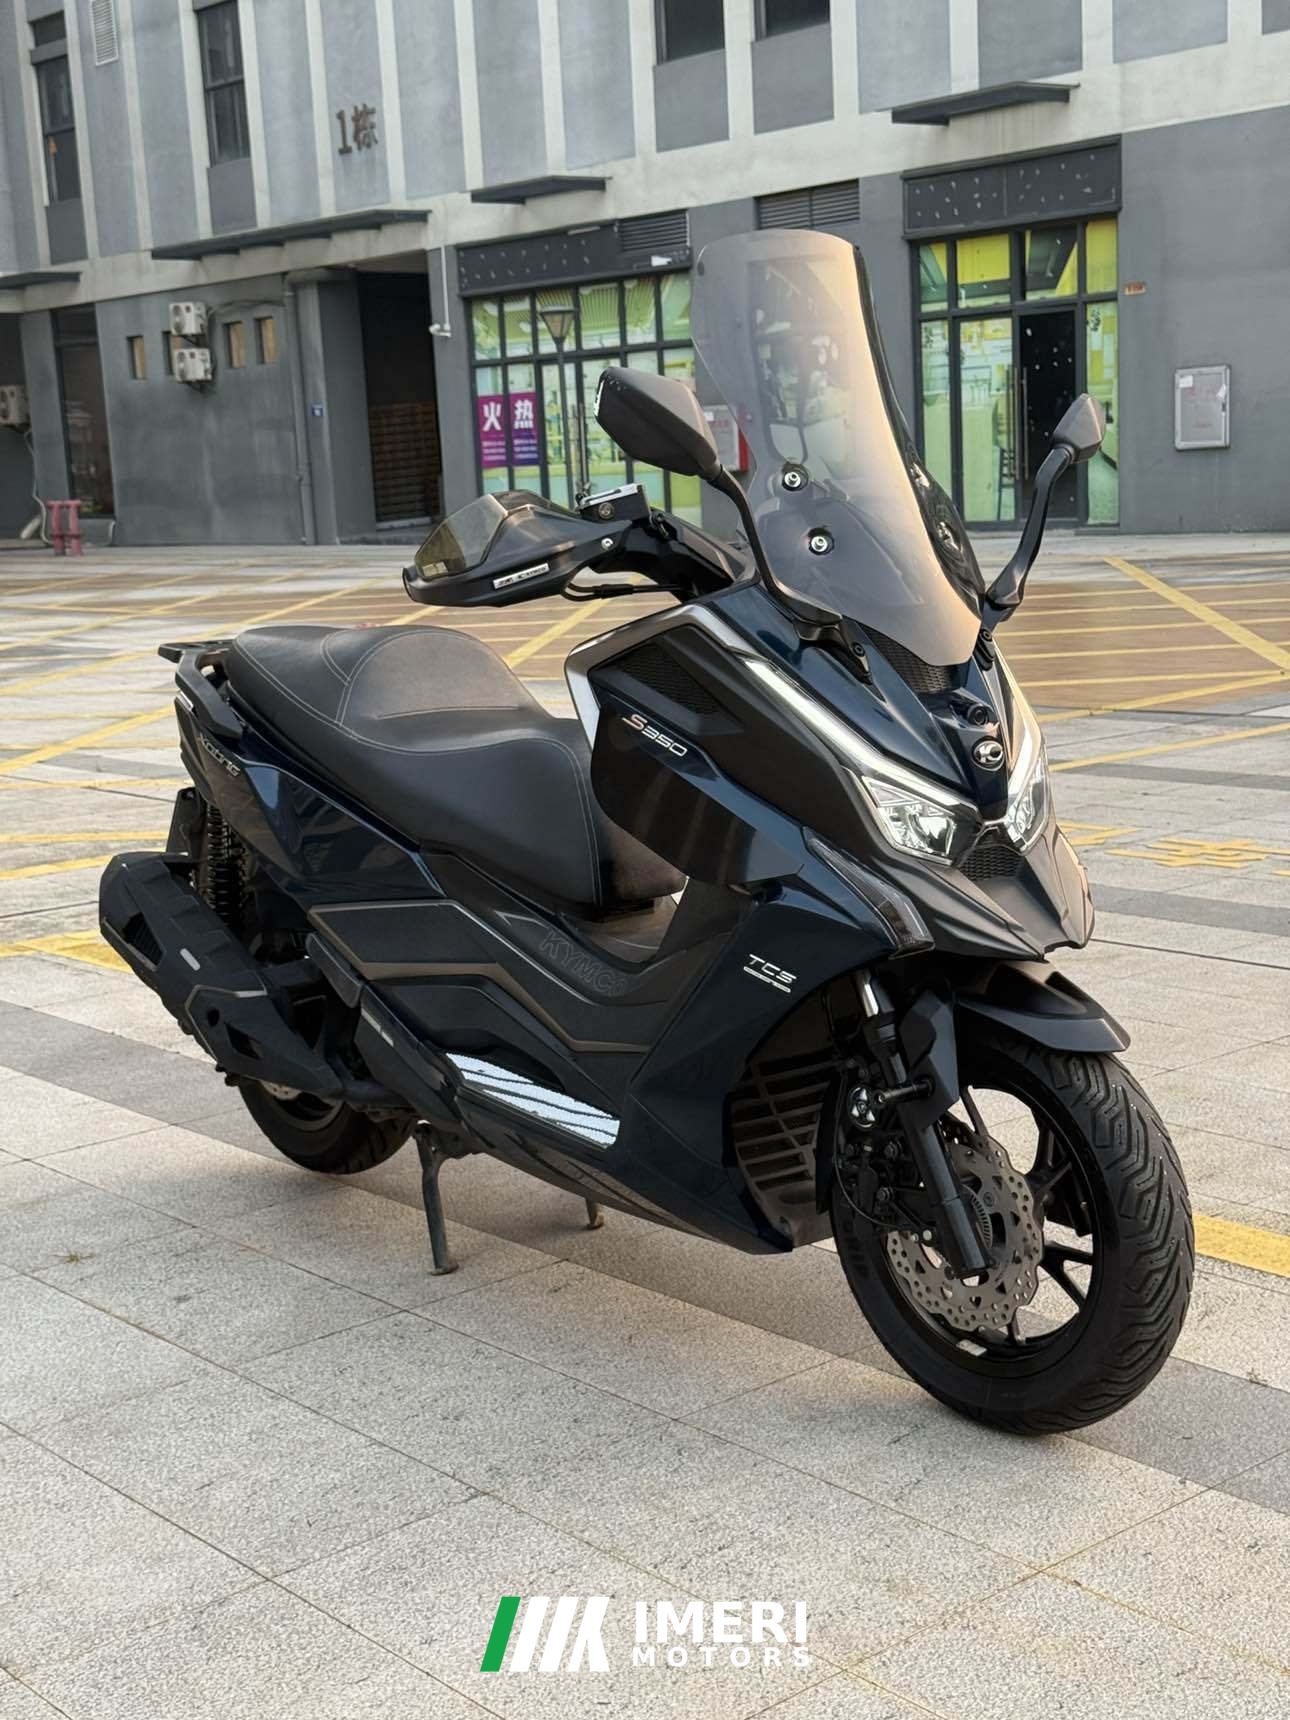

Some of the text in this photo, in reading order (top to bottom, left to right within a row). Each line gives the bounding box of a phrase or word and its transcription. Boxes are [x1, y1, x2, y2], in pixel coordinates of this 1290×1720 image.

[336, 103, 378, 155] 1栋
[482, 399, 534, 431] 火 热
[749, 953, 797, 984] TCS
